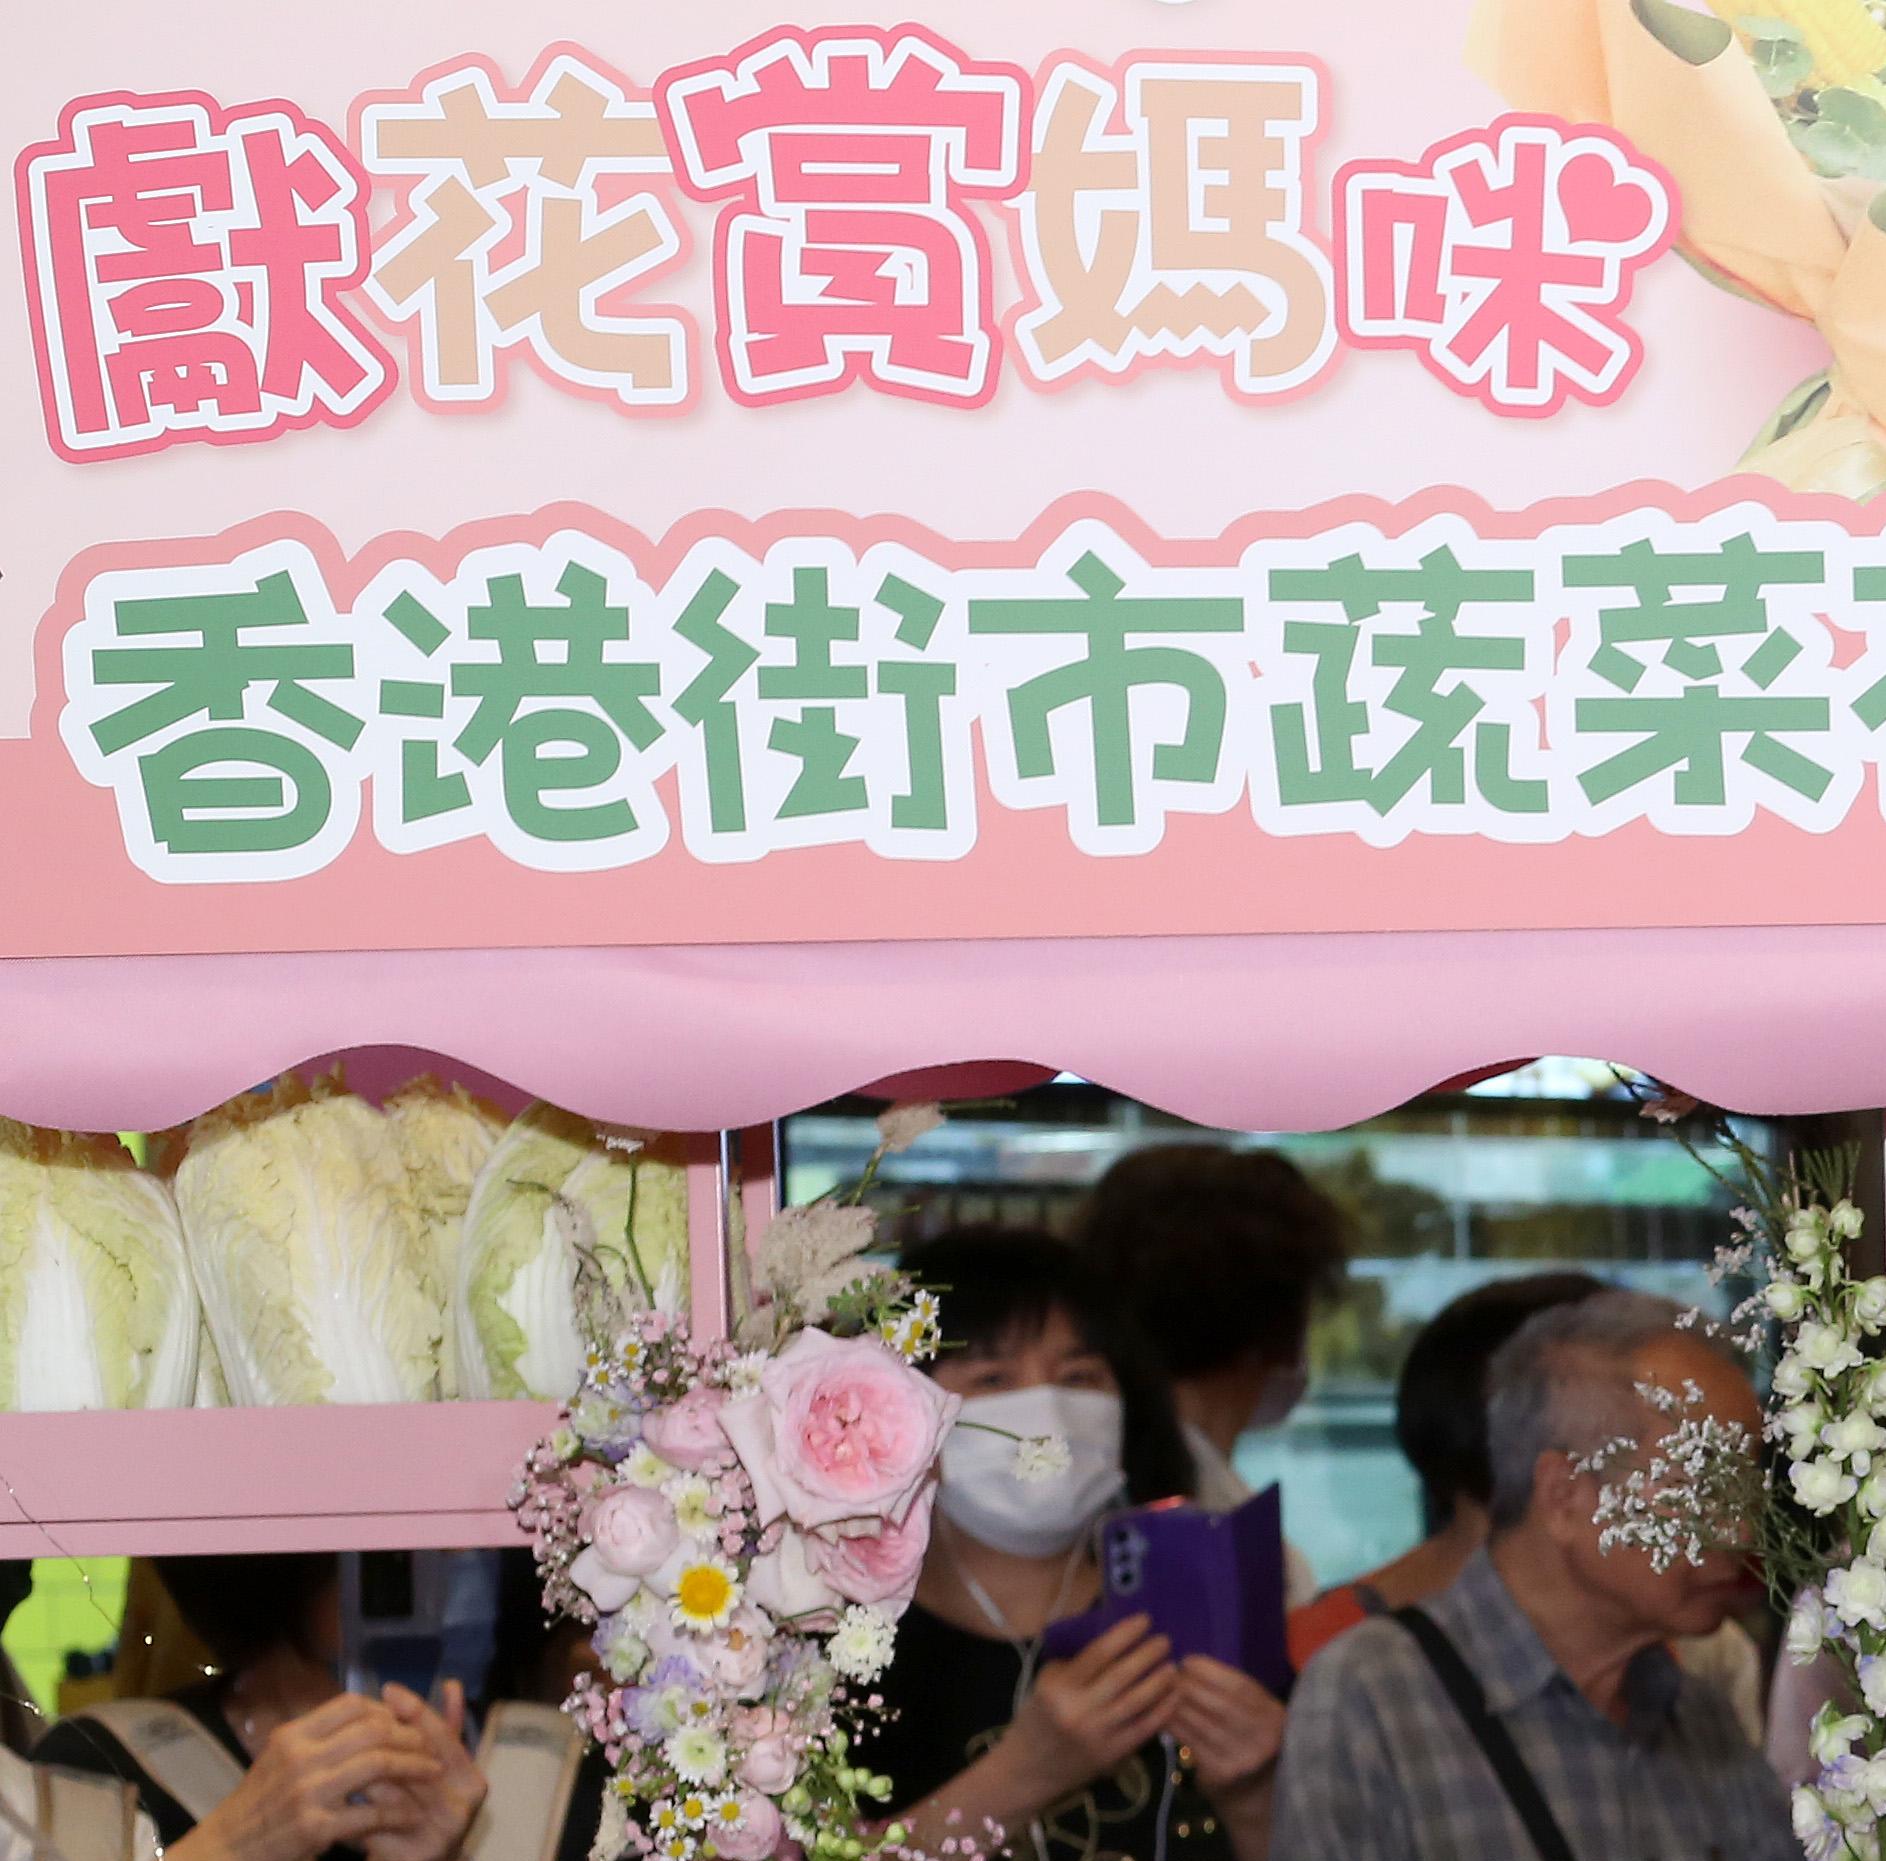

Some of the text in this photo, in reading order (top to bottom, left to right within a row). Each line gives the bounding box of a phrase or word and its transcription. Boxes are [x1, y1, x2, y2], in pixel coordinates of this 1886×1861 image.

[42, 35, 1660, 434] 獻花賞媽咪
